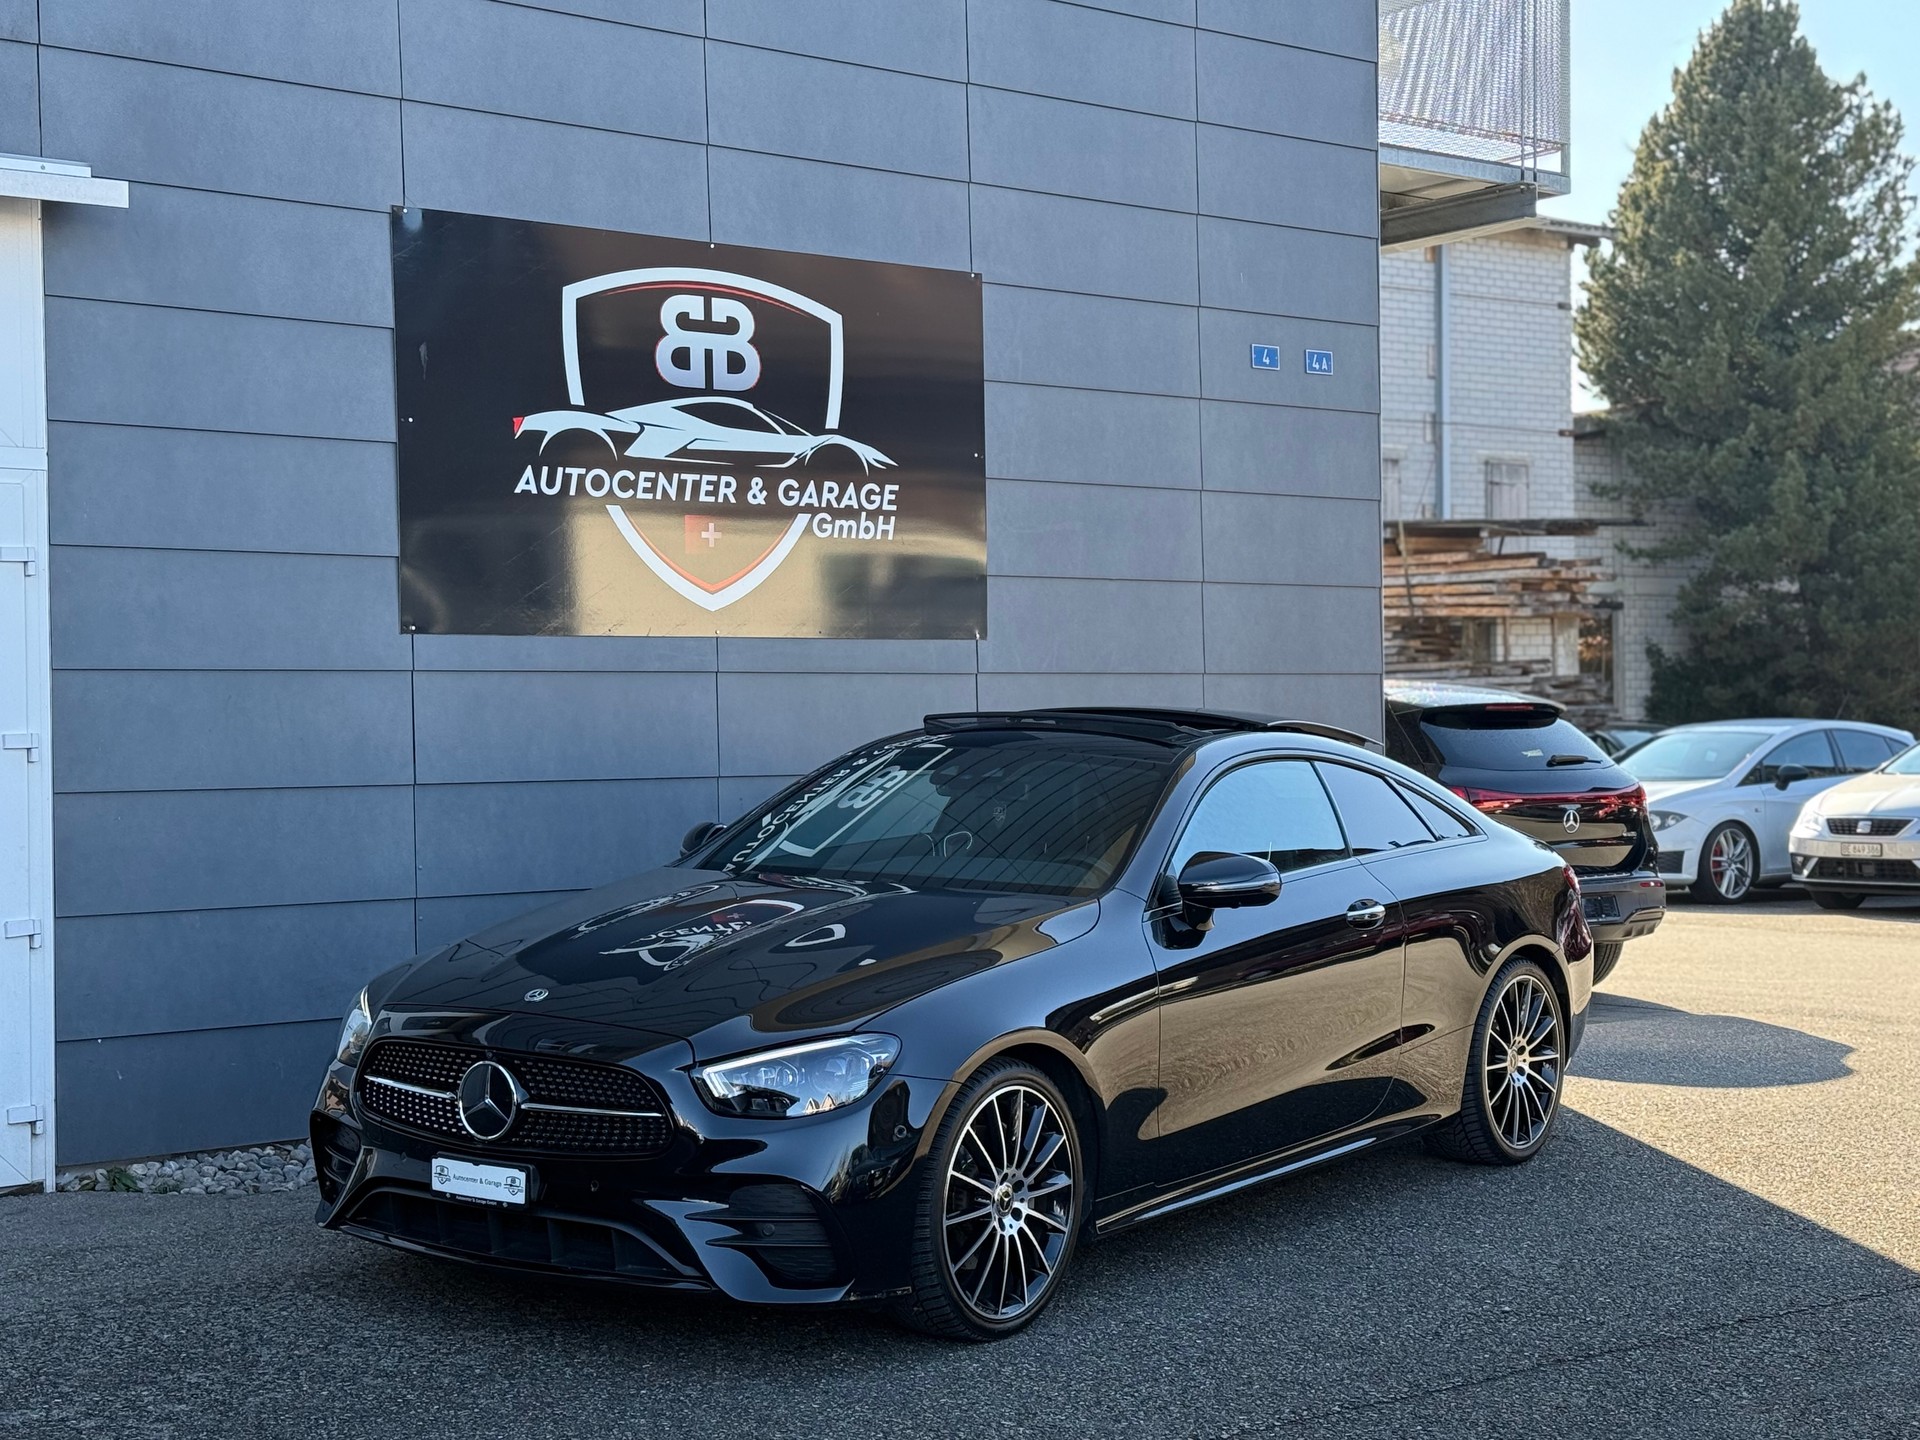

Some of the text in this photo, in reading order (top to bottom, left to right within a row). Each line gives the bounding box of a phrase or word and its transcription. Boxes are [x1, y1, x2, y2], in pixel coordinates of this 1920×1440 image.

[1262, 348, 1270, 365] 4
[1312, 354, 1328, 371] 4A
[513, 464, 900, 511] AUTOCENTER & GARAGE
[812, 511, 896, 541] GmbH
